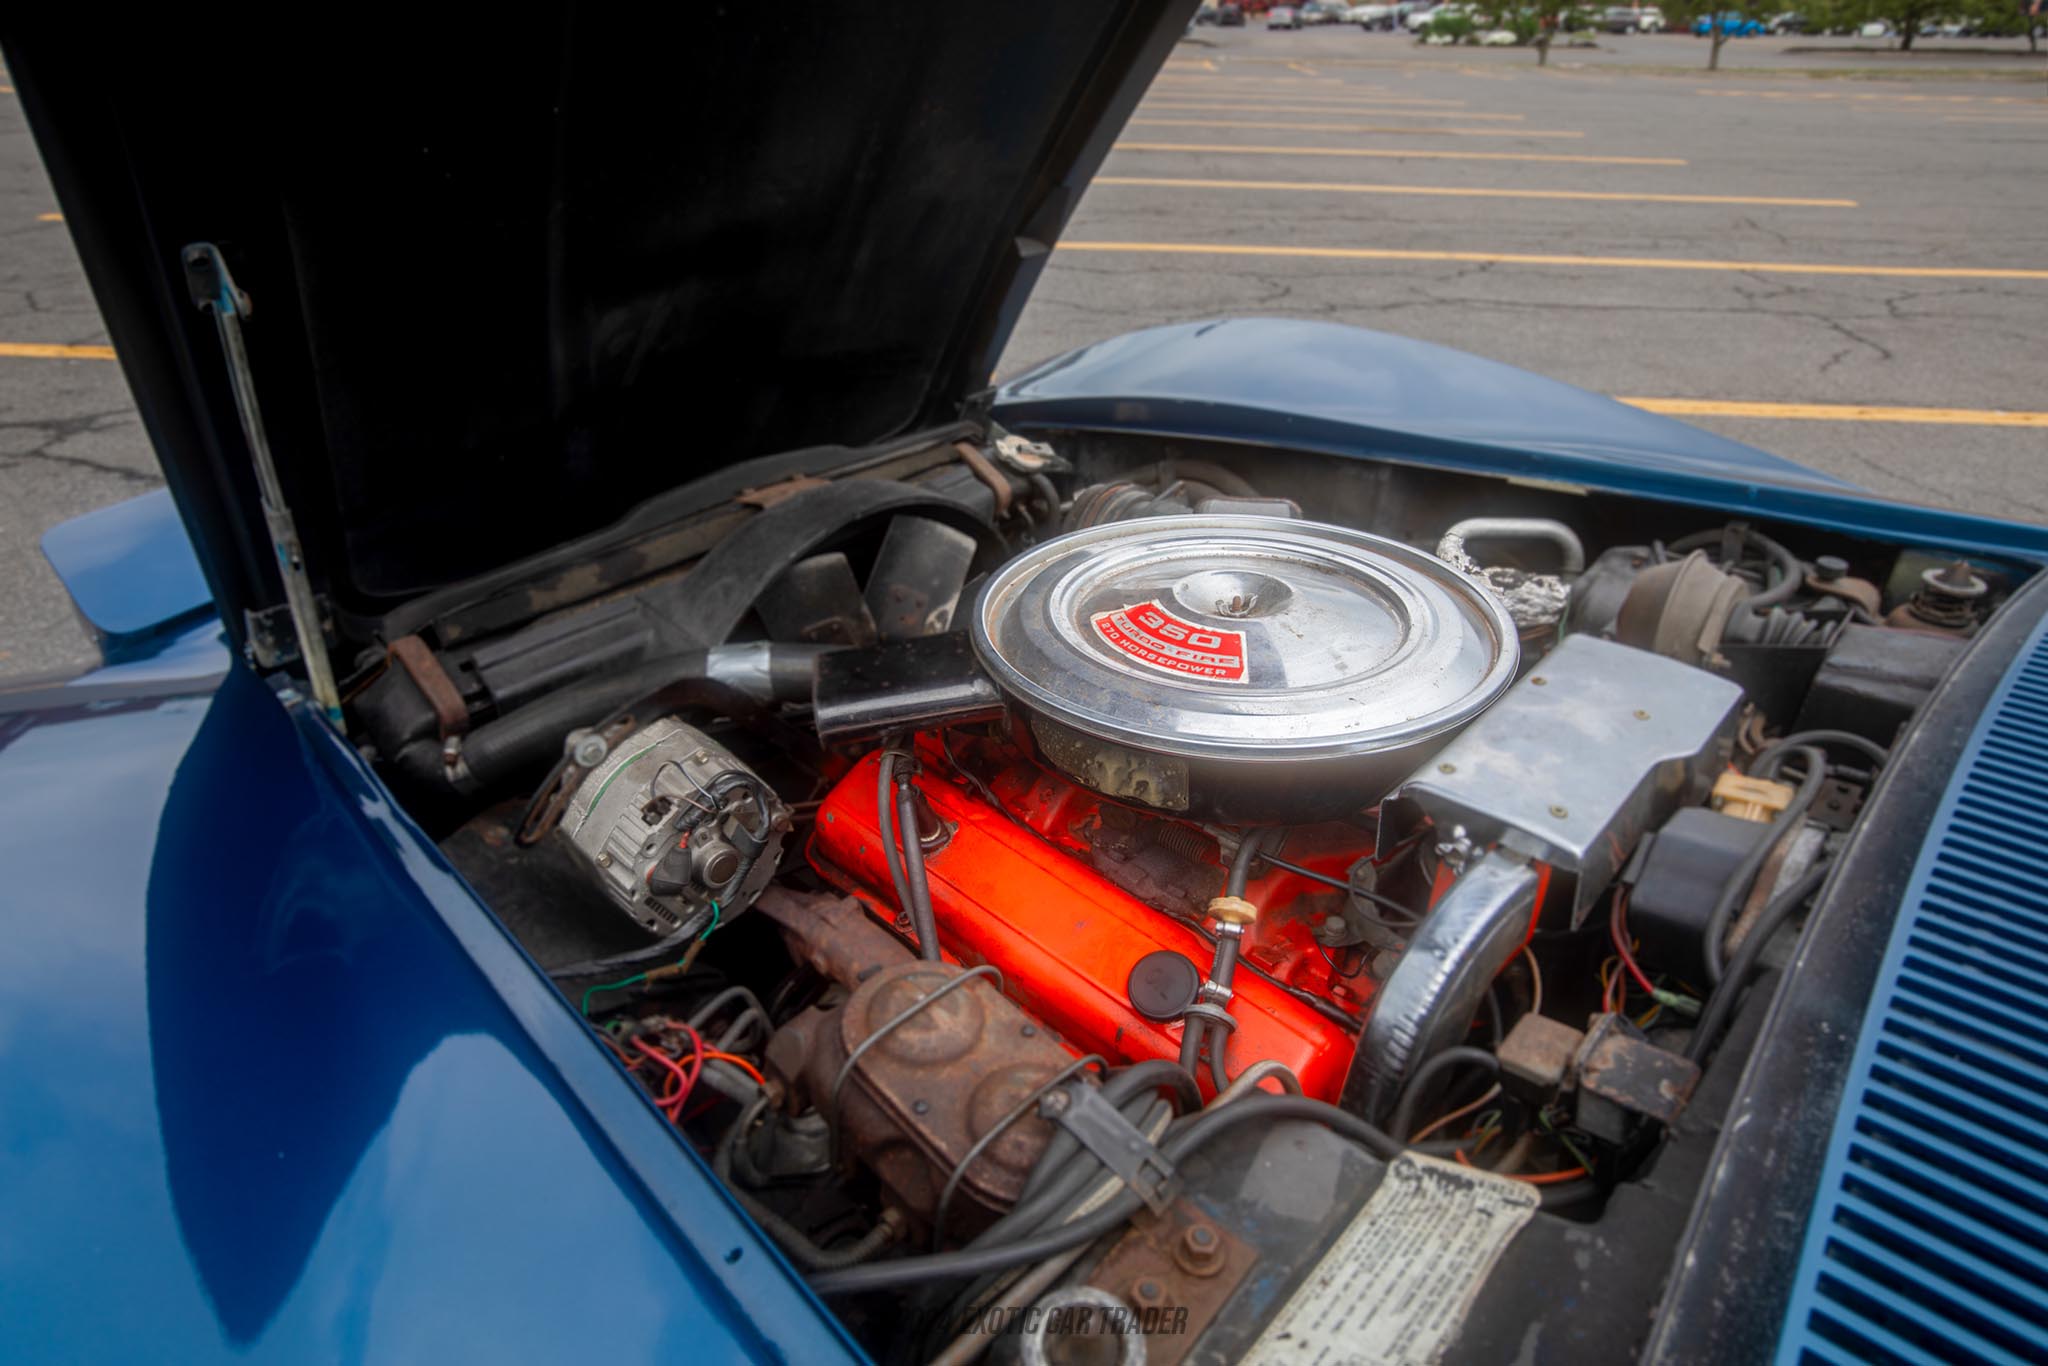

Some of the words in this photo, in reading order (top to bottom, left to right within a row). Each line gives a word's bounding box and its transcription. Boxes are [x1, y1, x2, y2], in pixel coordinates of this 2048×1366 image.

[1101, 622, 1120, 640] 270
[1119, 639, 1228, 677] HORSEPOWER
[1138, 611, 1222, 649] 350
